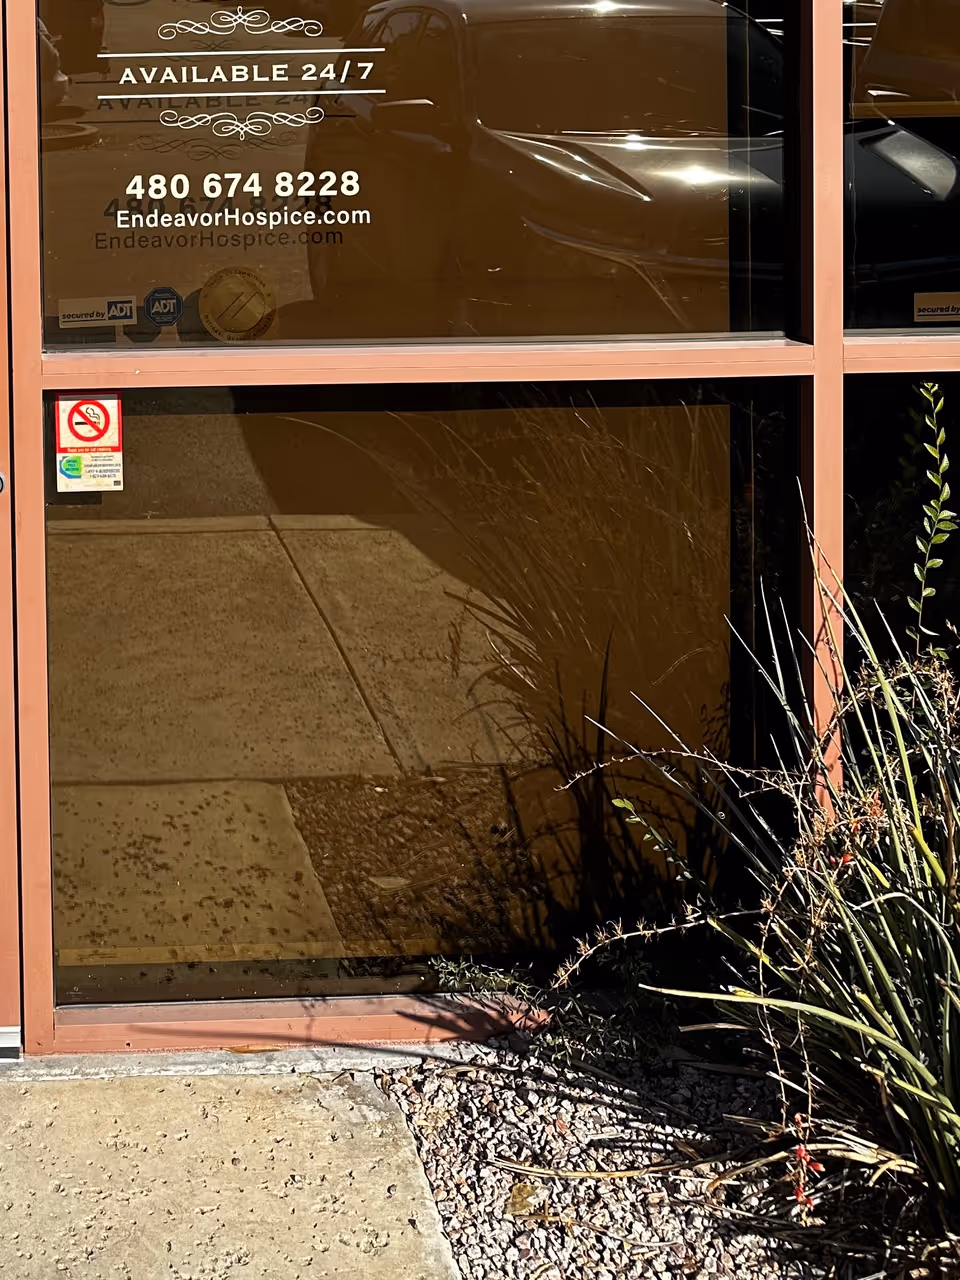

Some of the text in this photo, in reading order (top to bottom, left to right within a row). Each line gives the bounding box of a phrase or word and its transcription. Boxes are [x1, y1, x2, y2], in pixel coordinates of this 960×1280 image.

[119, 60, 374, 85] AVAILABLE 24/7
[125, 170, 360, 200] 480 674 8228
[117, 206, 371, 230] EndeavorHospice.com
[61, 302, 132, 320] secured by ADT
[151, 299, 176, 313] ADT
[917, 305, 950, 314] secured
